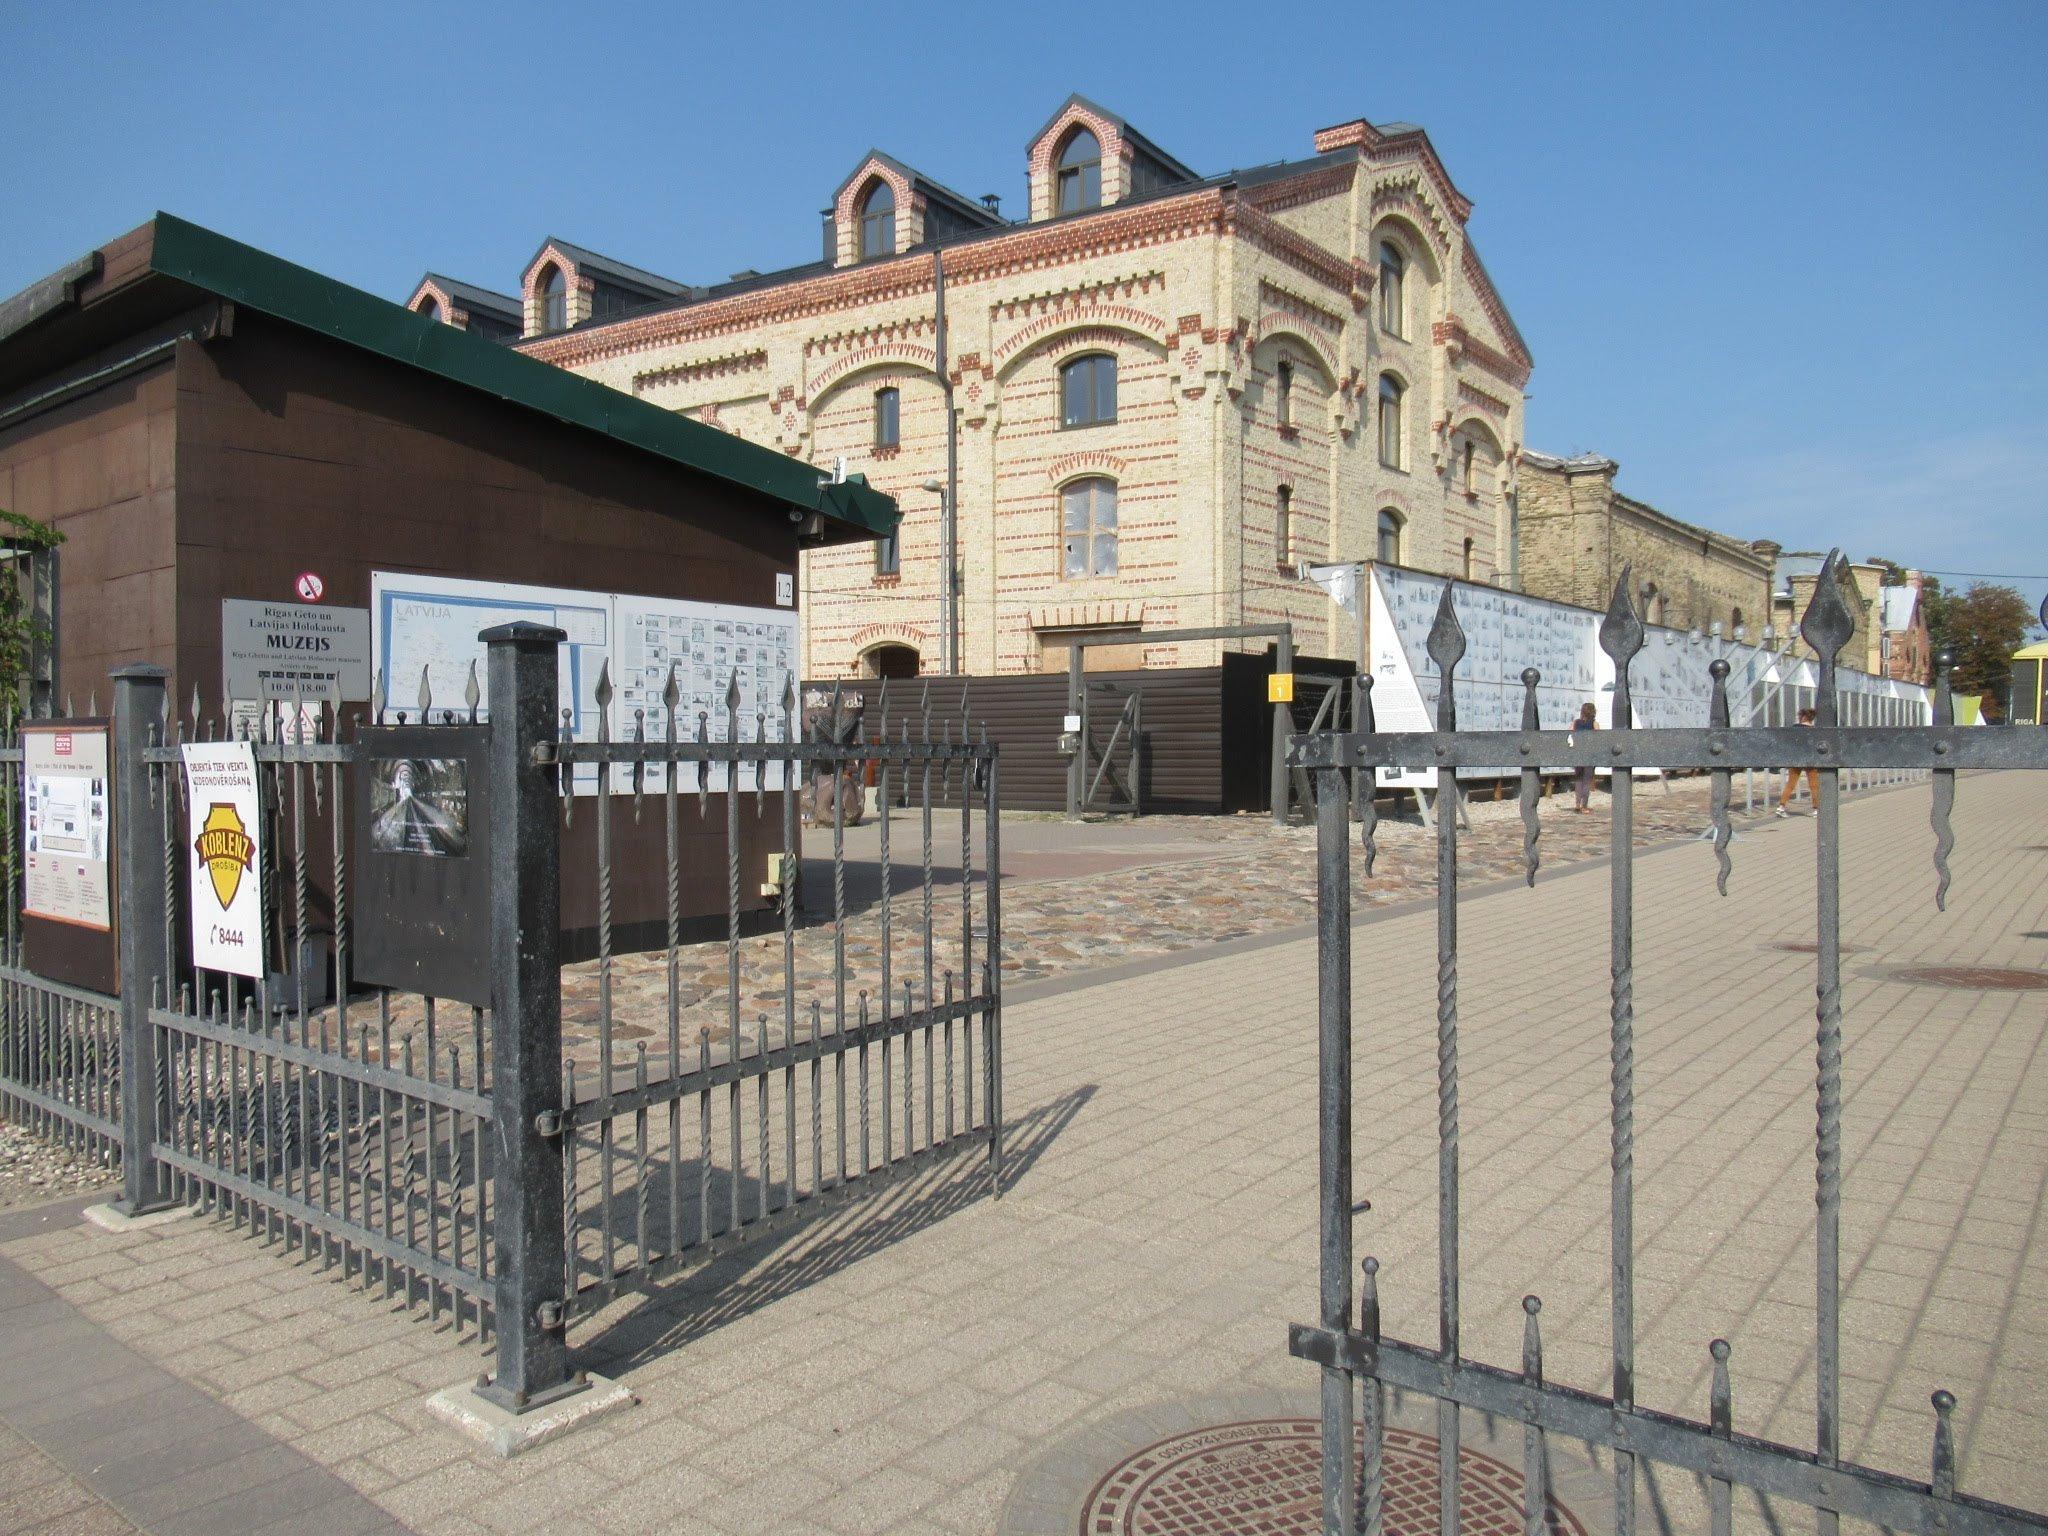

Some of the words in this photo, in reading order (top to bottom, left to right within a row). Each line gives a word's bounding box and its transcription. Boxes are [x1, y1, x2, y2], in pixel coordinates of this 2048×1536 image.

[778, 582, 791, 598] 1.2
[265, 607, 291, 618] Rīgas
[294, 609, 317, 619] Geto
[396, 604, 451, 619] LATVIJA
[249, 619, 290, 631] Latvijas
[293, 621, 346, 633] Holokausta
[267, 634, 331, 652] MUZEJS
[1277, 686, 1282, 698] 1
[213, 762, 225, 772] TIEK
[226, 762, 249, 772] VEIKTA
[201, 831, 250, 862] KOBLENZ
[219, 927, 244, 947] 8444
